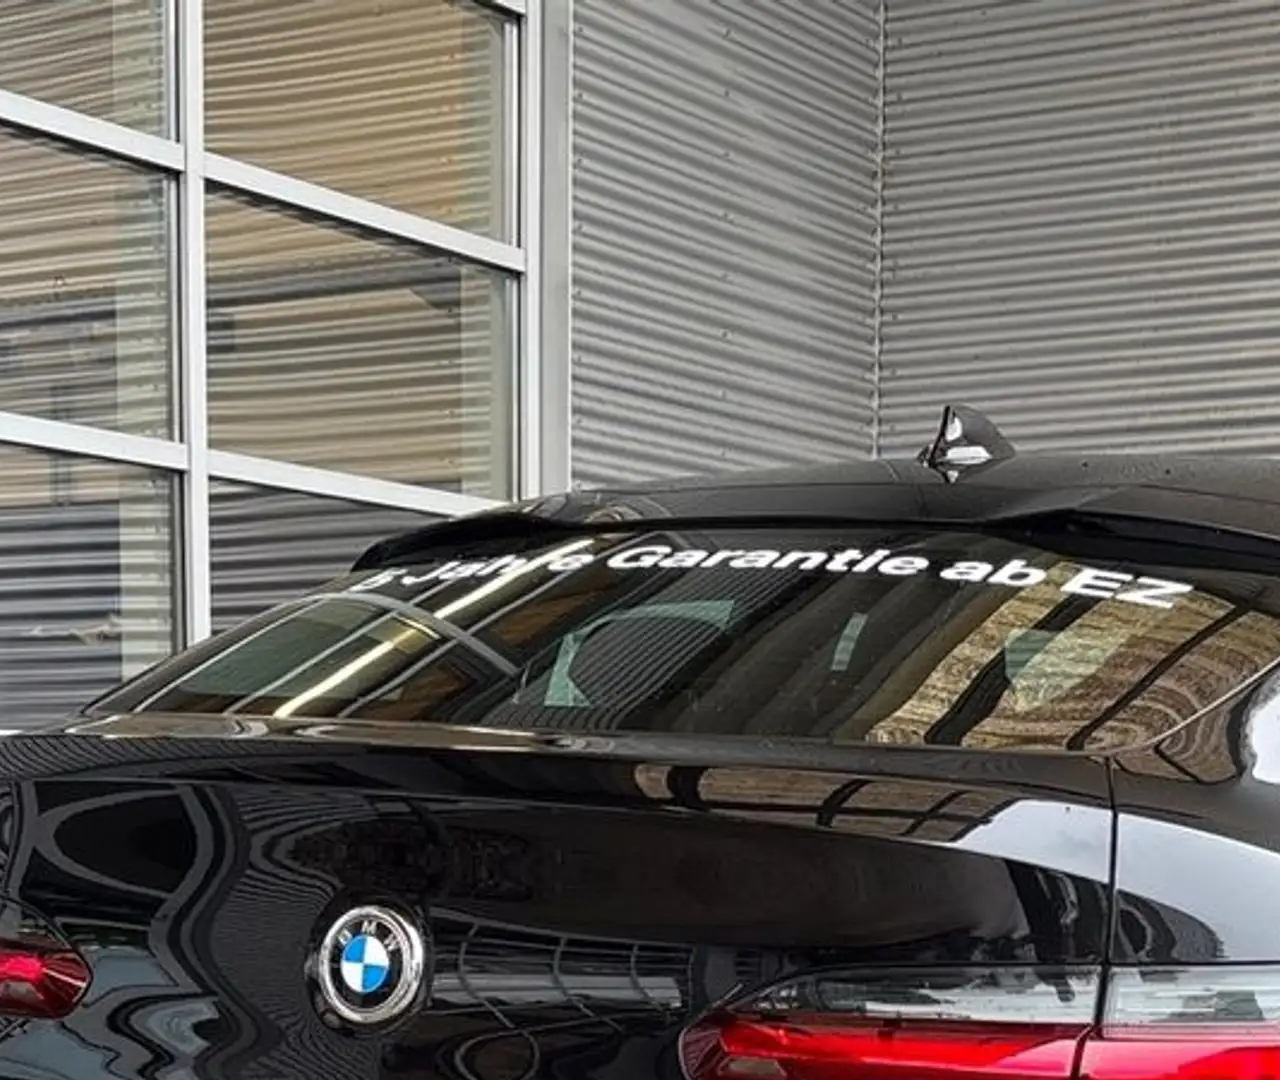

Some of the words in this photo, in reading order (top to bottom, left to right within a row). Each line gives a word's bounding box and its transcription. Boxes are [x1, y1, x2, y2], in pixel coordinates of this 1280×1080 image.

[606, 545, 930, 575] Garantie
[939, 559, 1047, 586] ab
[1060, 567, 1194, 608] EZ
[337, 919, 402, 952] BMW
